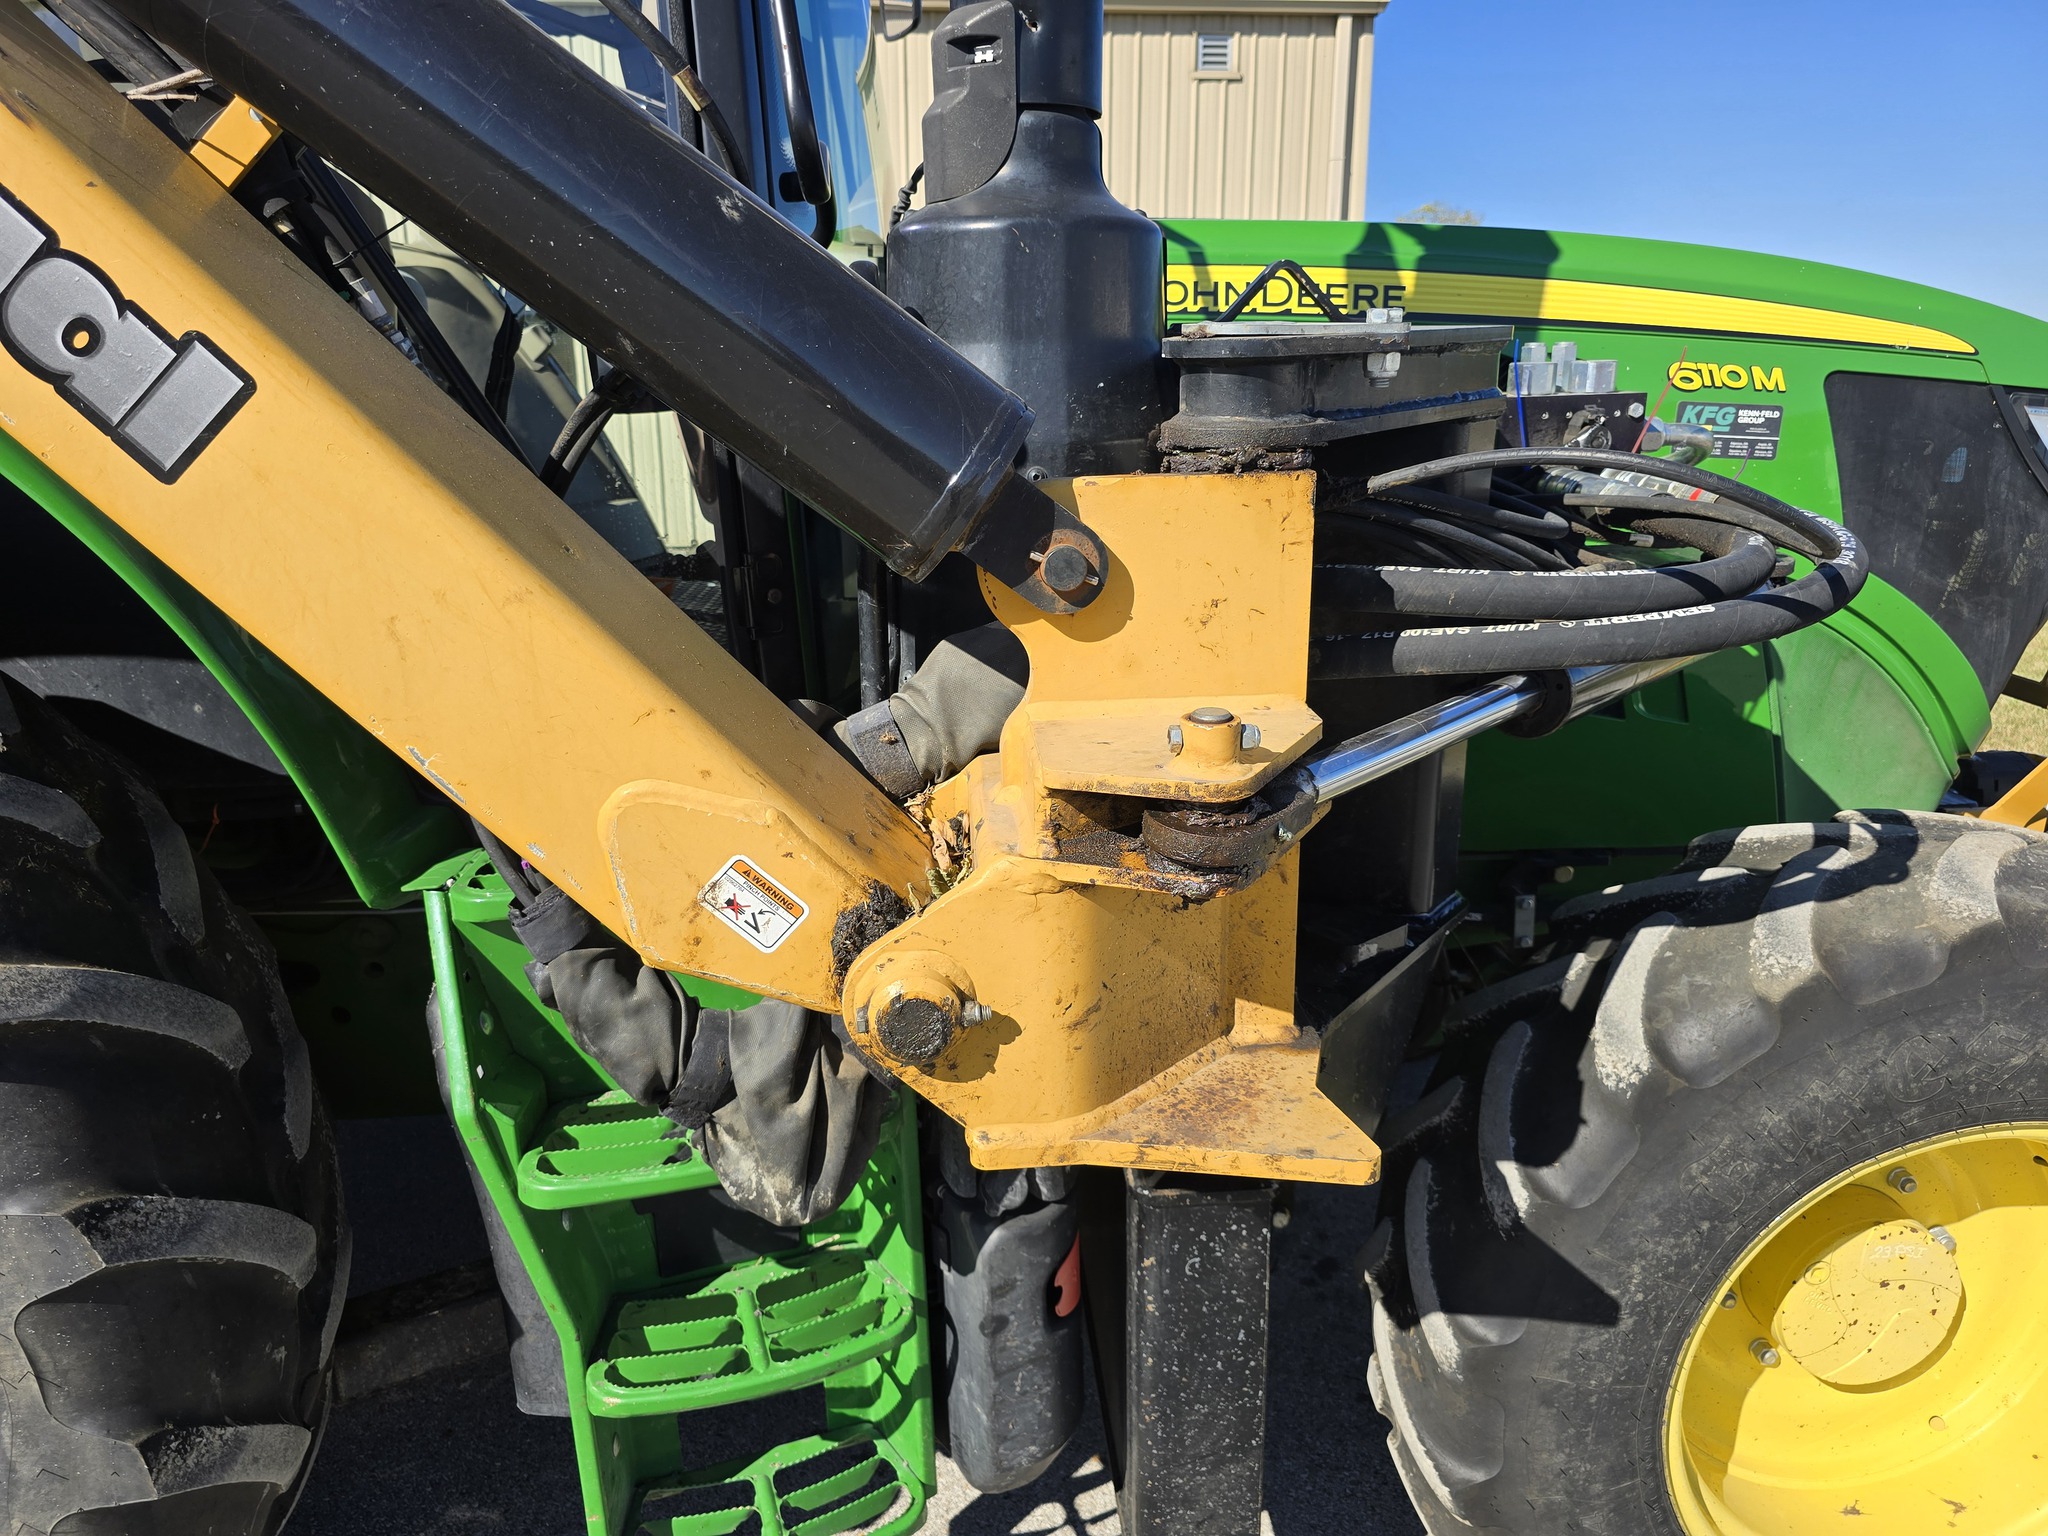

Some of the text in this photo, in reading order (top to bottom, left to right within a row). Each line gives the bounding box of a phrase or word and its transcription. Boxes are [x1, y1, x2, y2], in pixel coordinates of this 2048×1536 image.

[1166, 275, 1407, 311] OHN DEERE
[1681, 405, 1737, 425] KFG
[1737, 416, 1766, 424] GROUP
[1584, 604, 1716, 627] SEMPERIT
[1400, 626, 1471, 638] SAE100
[1482, 622, 1540, 633] KURT
[743, 880, 780, 912] PINCH POINTS
[752, 875, 795, 911] WARNING
[1869, 1245, 1928, 1259] 23 PSI
